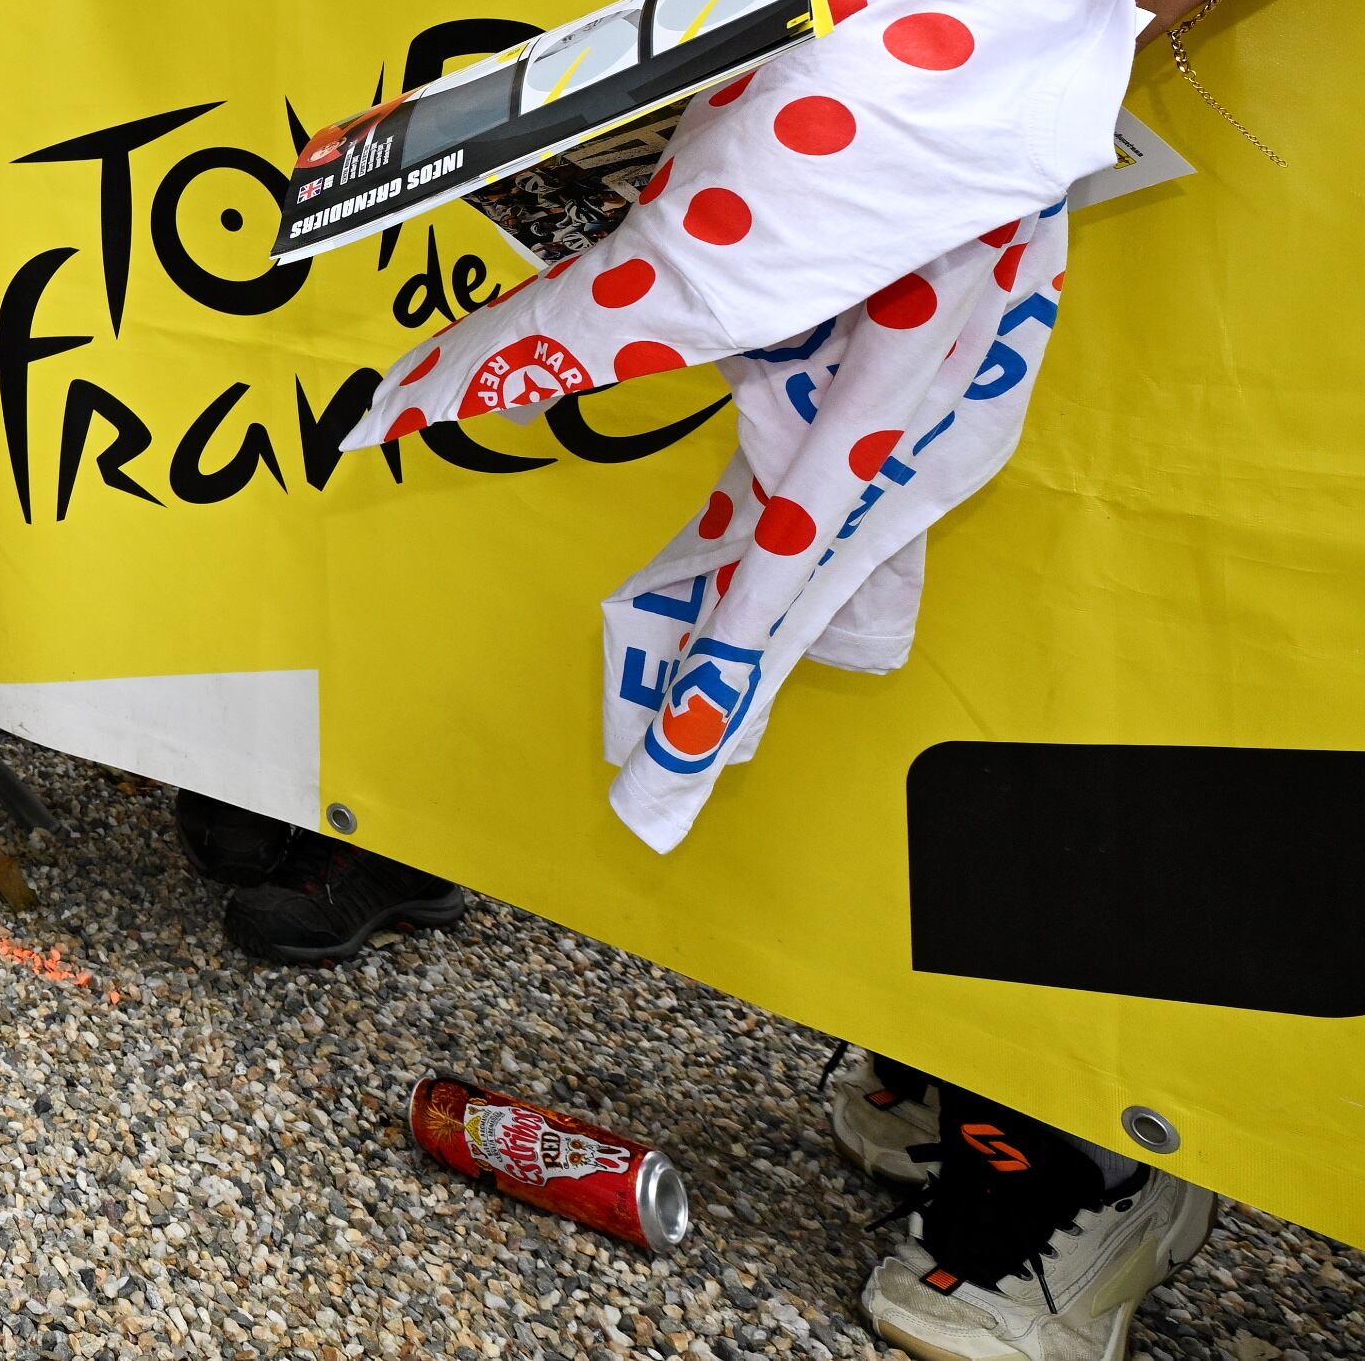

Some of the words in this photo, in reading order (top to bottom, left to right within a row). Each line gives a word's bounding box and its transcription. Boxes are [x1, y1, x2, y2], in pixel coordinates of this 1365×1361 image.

[406, 148, 464, 190] INEOS
[289, 177, 403, 239] GRENADIERS
[394, 225, 501, 329] de
[540, 1130, 563, 1171] RED
